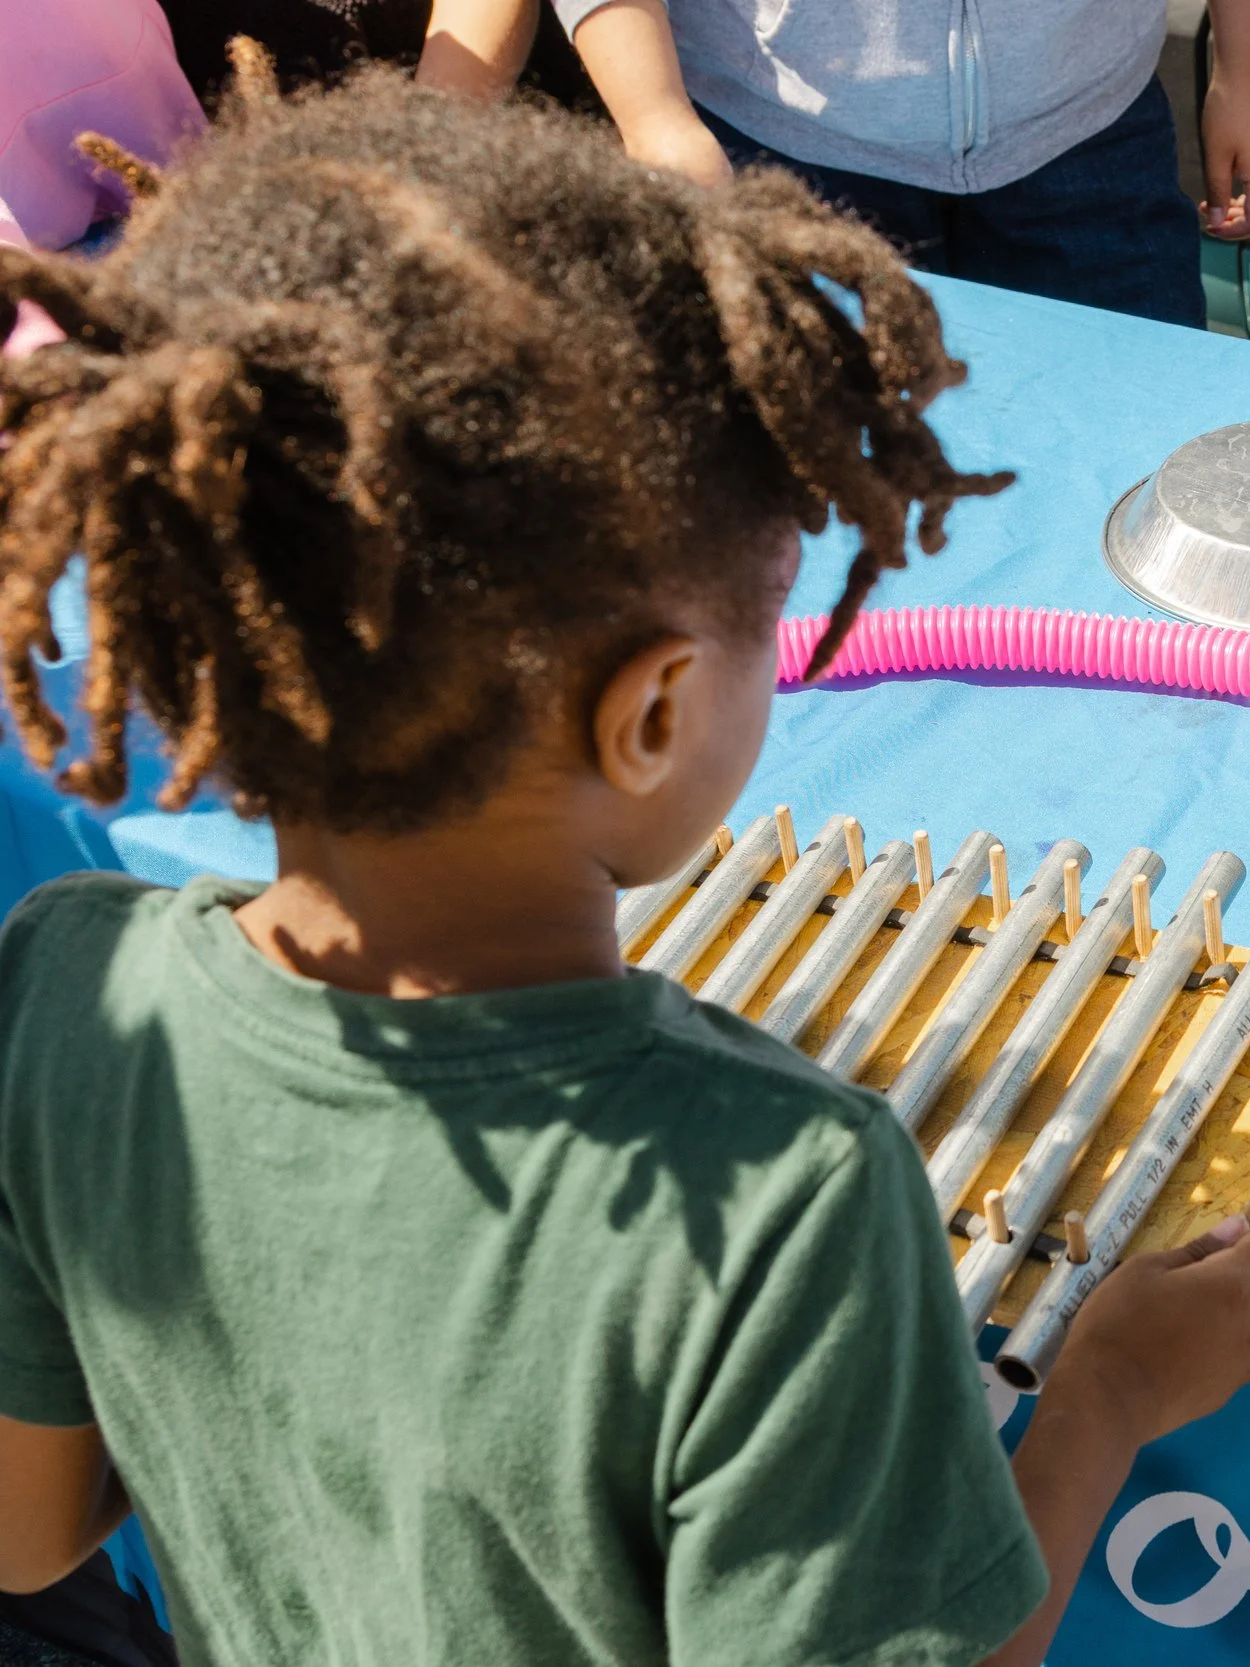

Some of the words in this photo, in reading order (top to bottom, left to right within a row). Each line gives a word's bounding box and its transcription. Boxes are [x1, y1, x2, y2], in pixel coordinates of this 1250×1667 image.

[1119, 1191, 1148, 1230] PULL
[1147, 1157, 1167, 1185] 1/2
[1165, 1135, 1180, 1155] IN
[1180, 1097, 1203, 1131] EMT
